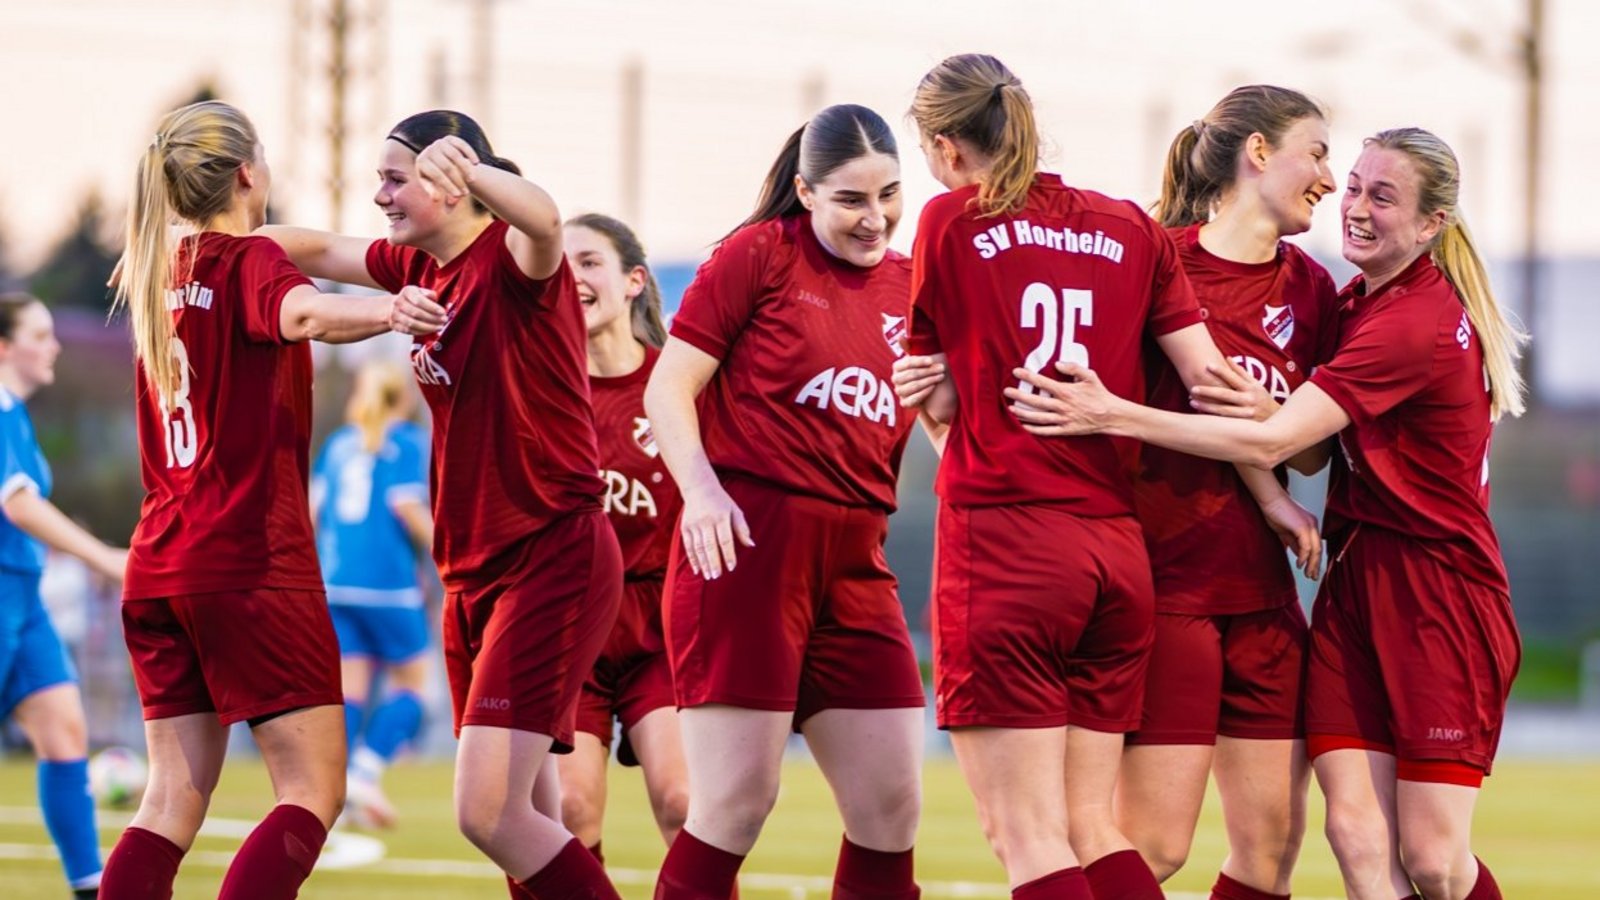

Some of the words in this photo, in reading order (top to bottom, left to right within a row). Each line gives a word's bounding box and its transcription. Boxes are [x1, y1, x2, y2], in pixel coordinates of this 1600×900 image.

[973, 224, 1011, 259] SV
[1013, 220, 1124, 264] Horrheim
[797, 289, 830, 309] JAKO
[1014, 282, 1093, 412] 25
[794, 366, 897, 428] AERA
[475, 696, 511, 711] JAKO
[1426, 727, 1464, 741] JAKO
